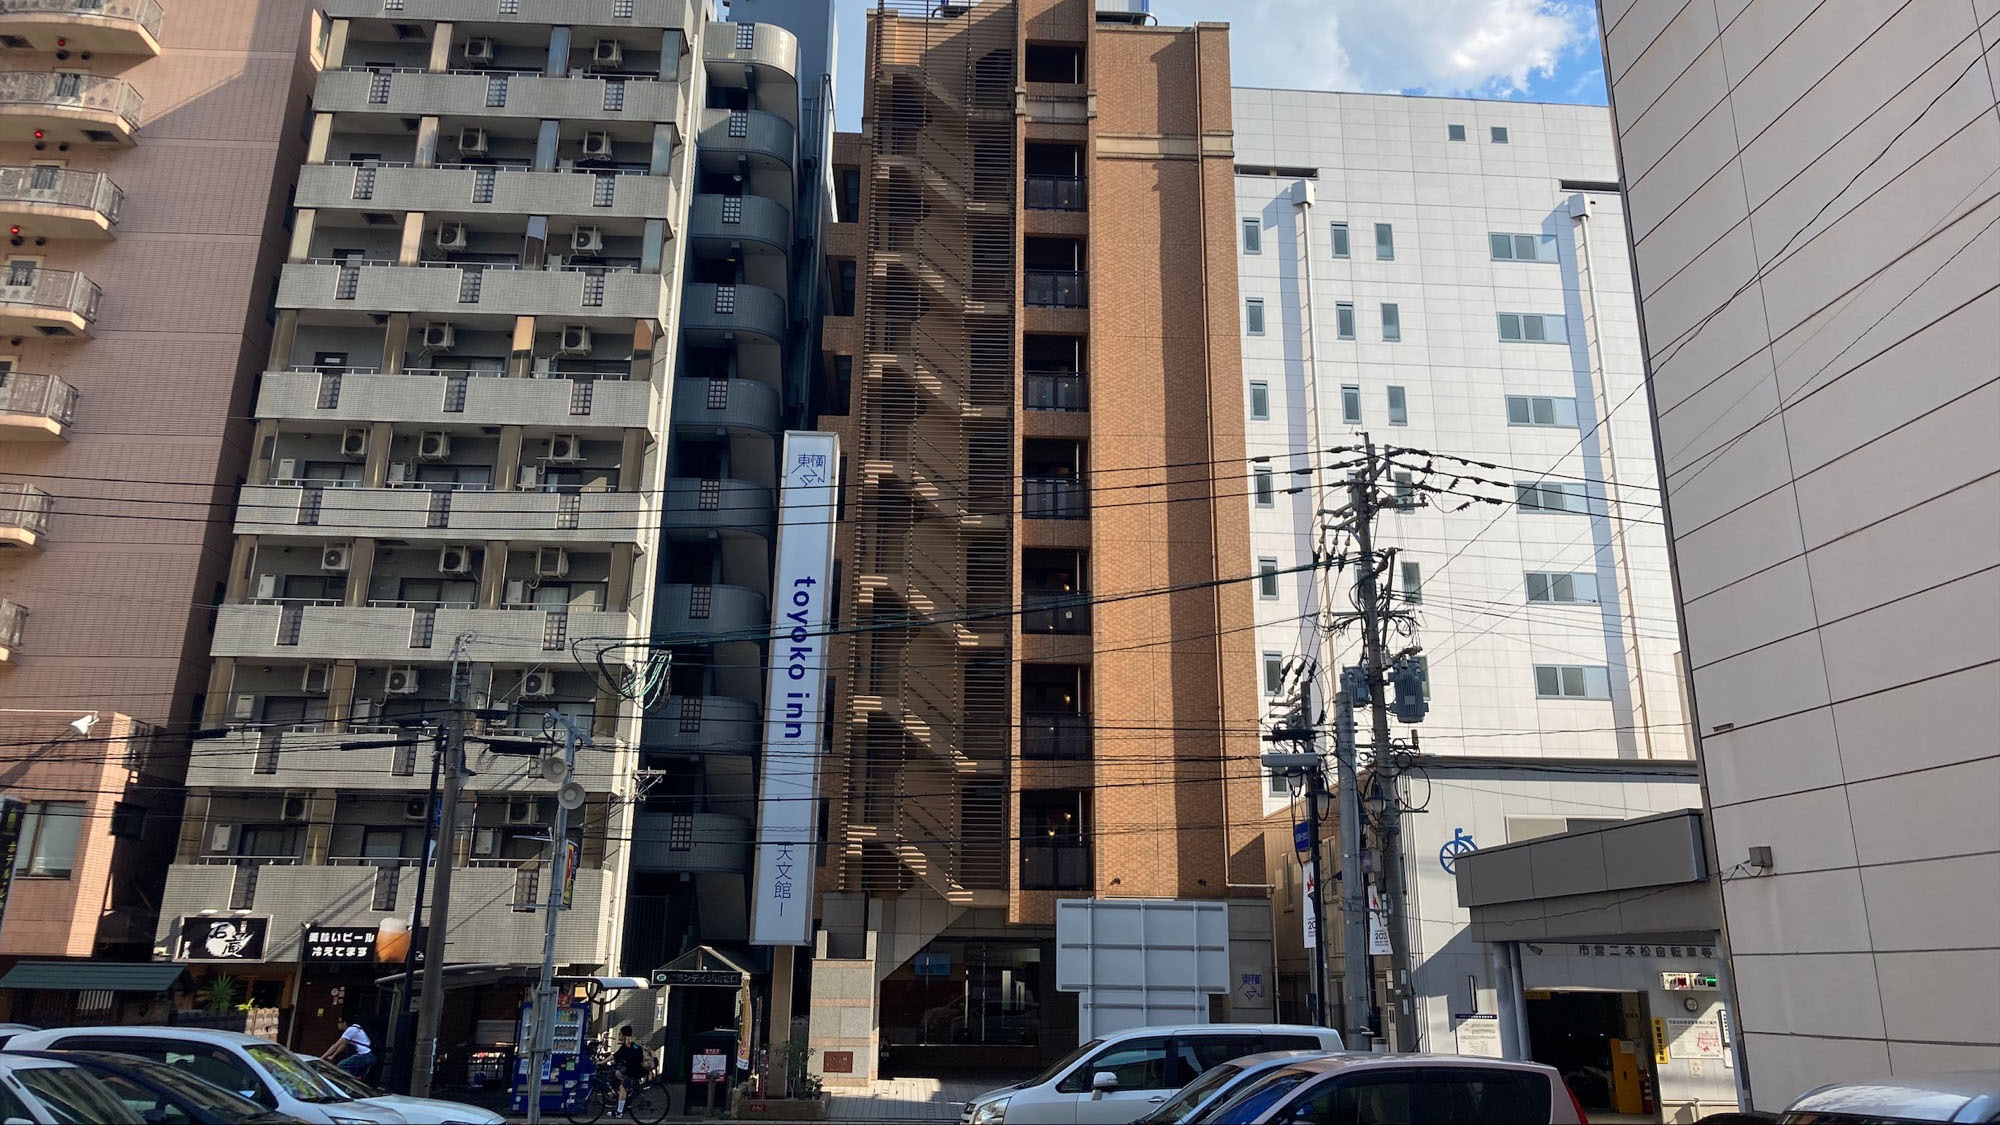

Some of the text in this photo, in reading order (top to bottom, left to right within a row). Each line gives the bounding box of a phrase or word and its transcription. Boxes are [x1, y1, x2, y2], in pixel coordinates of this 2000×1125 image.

[784, 576, 816, 738] toyoko inn
[308, 932, 375, 943] 美味いビール
[312, 946, 368, 957] 冷えてます
